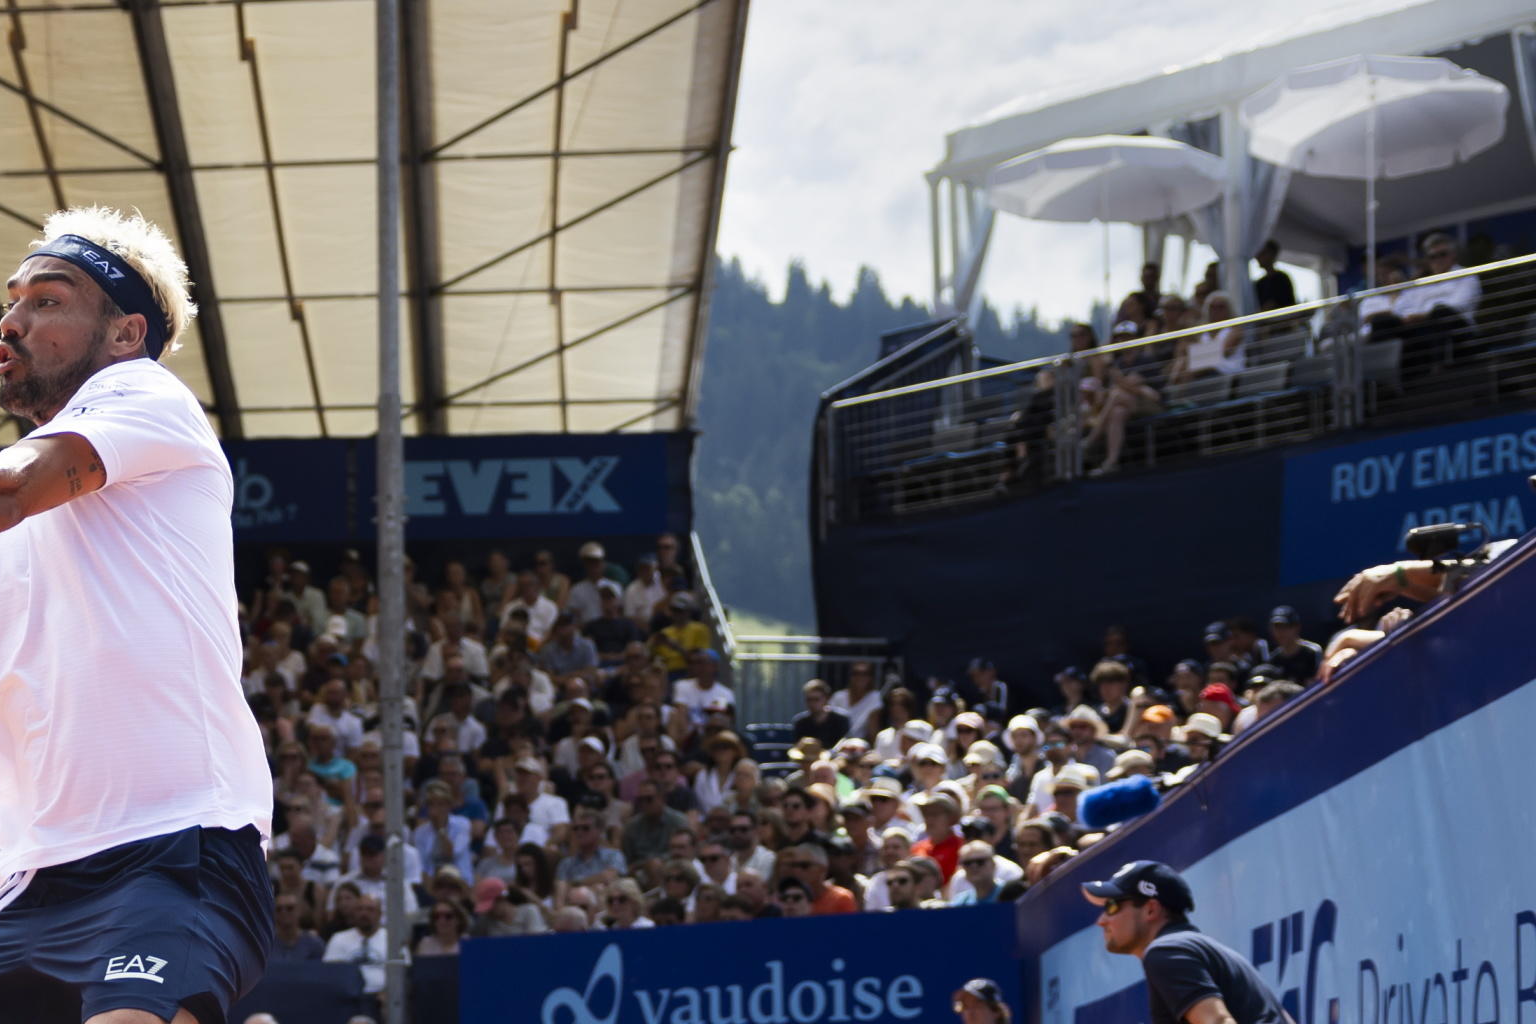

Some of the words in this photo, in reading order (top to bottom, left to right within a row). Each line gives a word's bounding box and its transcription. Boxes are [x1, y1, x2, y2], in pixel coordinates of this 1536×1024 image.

[83, 250, 125, 279] EA7
[1331, 452, 1406, 503] ROY
[106, 954, 168, 977] EA7
